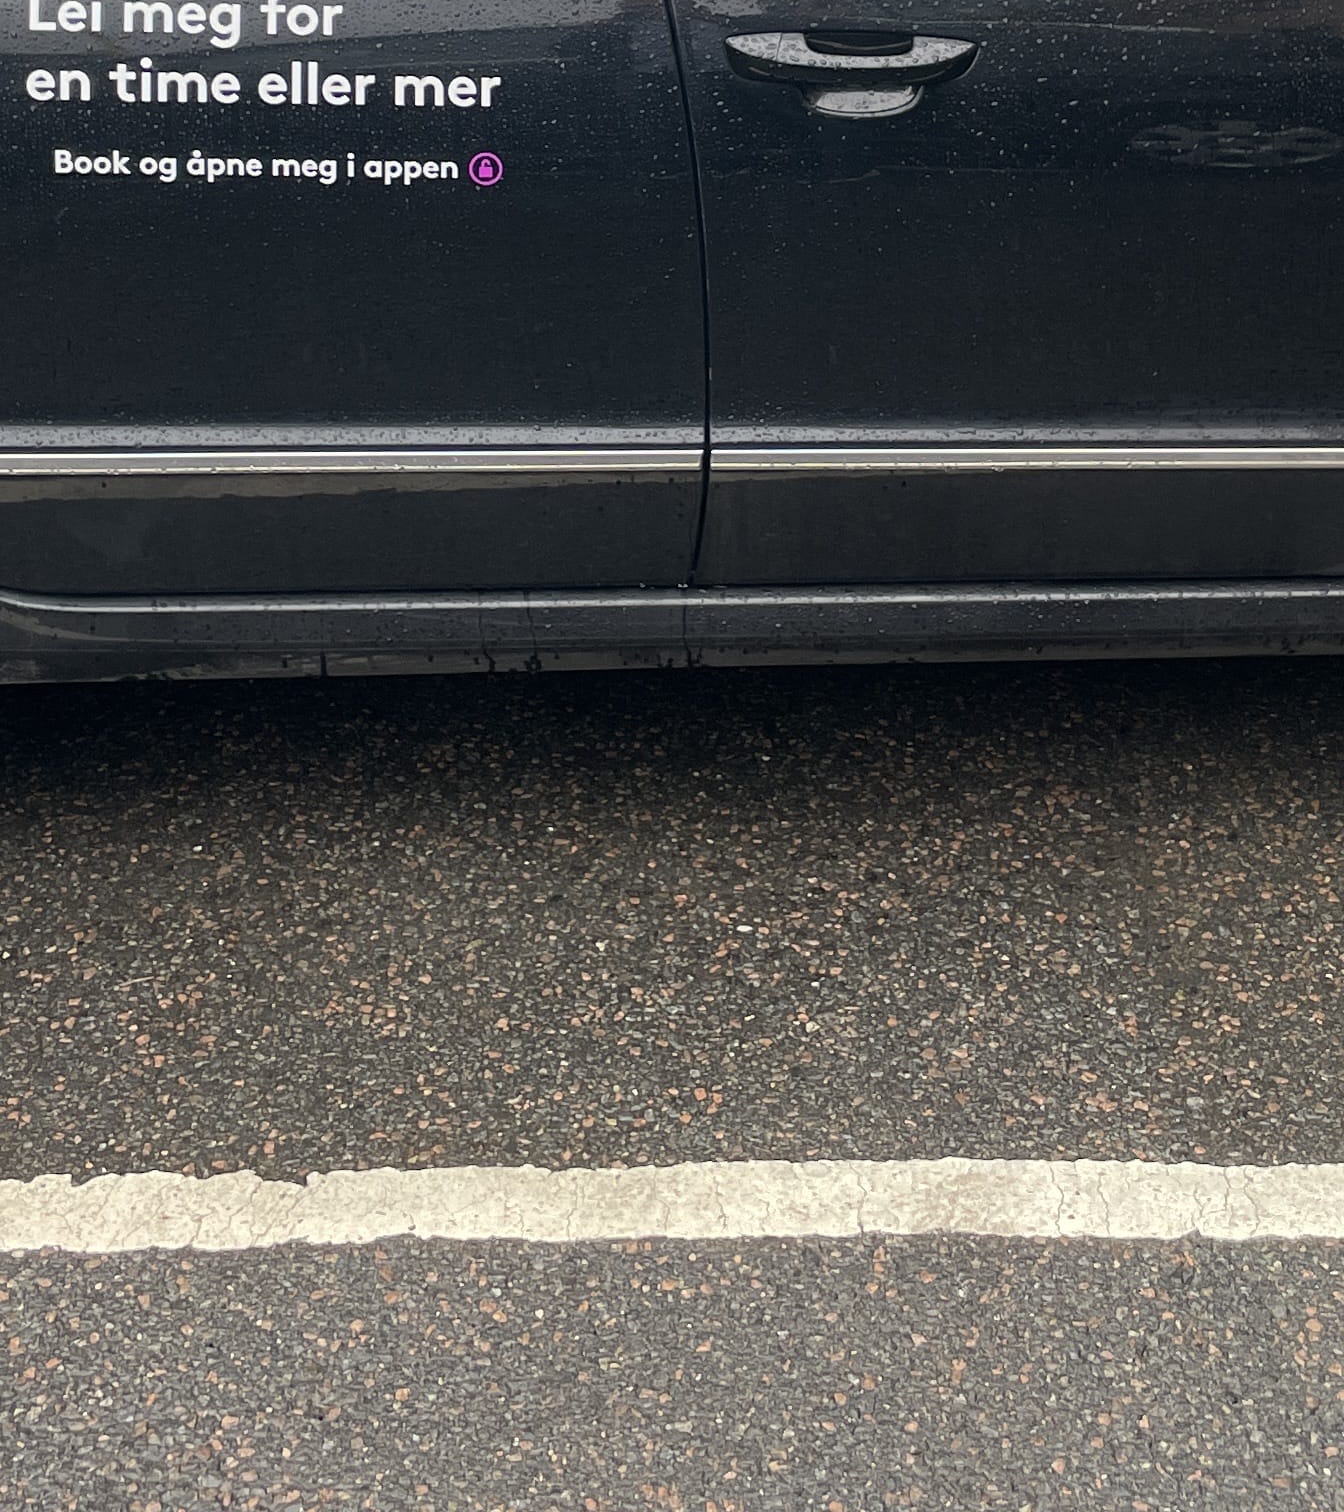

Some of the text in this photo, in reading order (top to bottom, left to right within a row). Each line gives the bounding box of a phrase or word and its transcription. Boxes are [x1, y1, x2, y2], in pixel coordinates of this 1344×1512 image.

[124, 2, 241, 48] meg
[27, 57, 500, 106] en time eller mer
[55, 150, 458, 185] Book og åpne meg i appen
